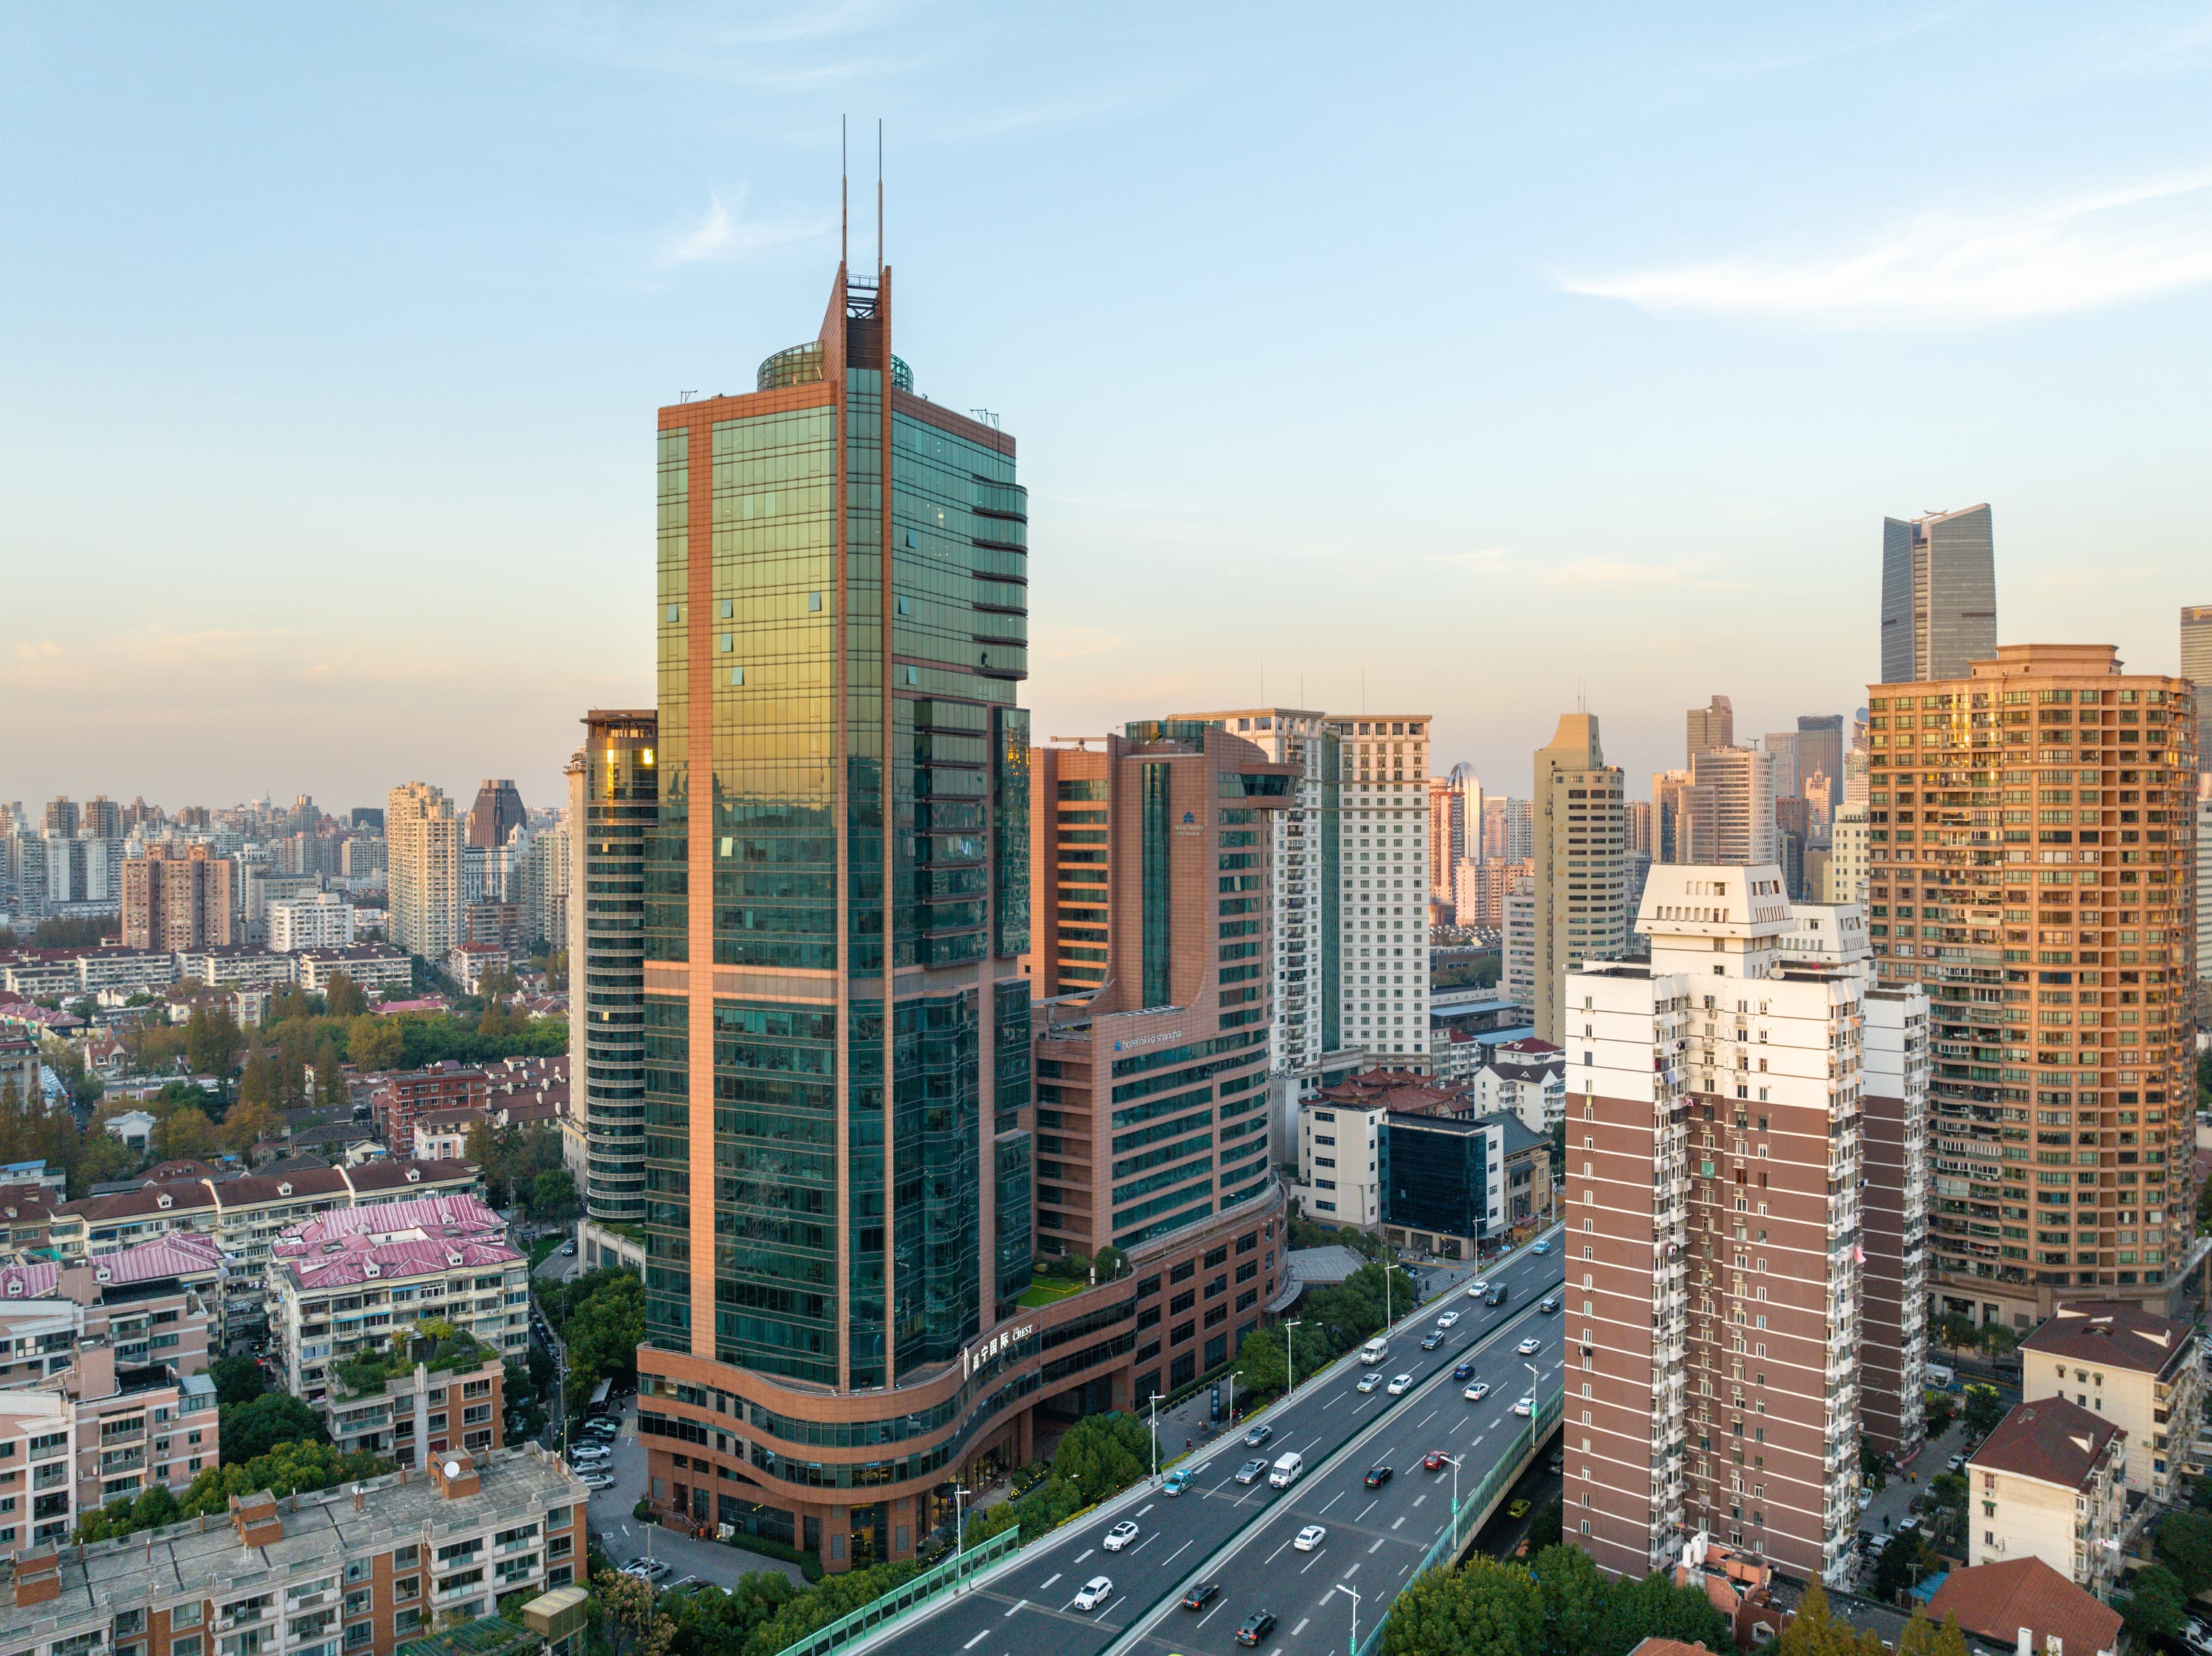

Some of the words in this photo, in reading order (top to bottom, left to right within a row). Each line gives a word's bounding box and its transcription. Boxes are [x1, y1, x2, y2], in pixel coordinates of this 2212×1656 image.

[1122, 1038, 1138, 1049] hotel
[1139, 1036, 1155, 1045] nikko
[1012, 1324, 1033, 1341] CREST
